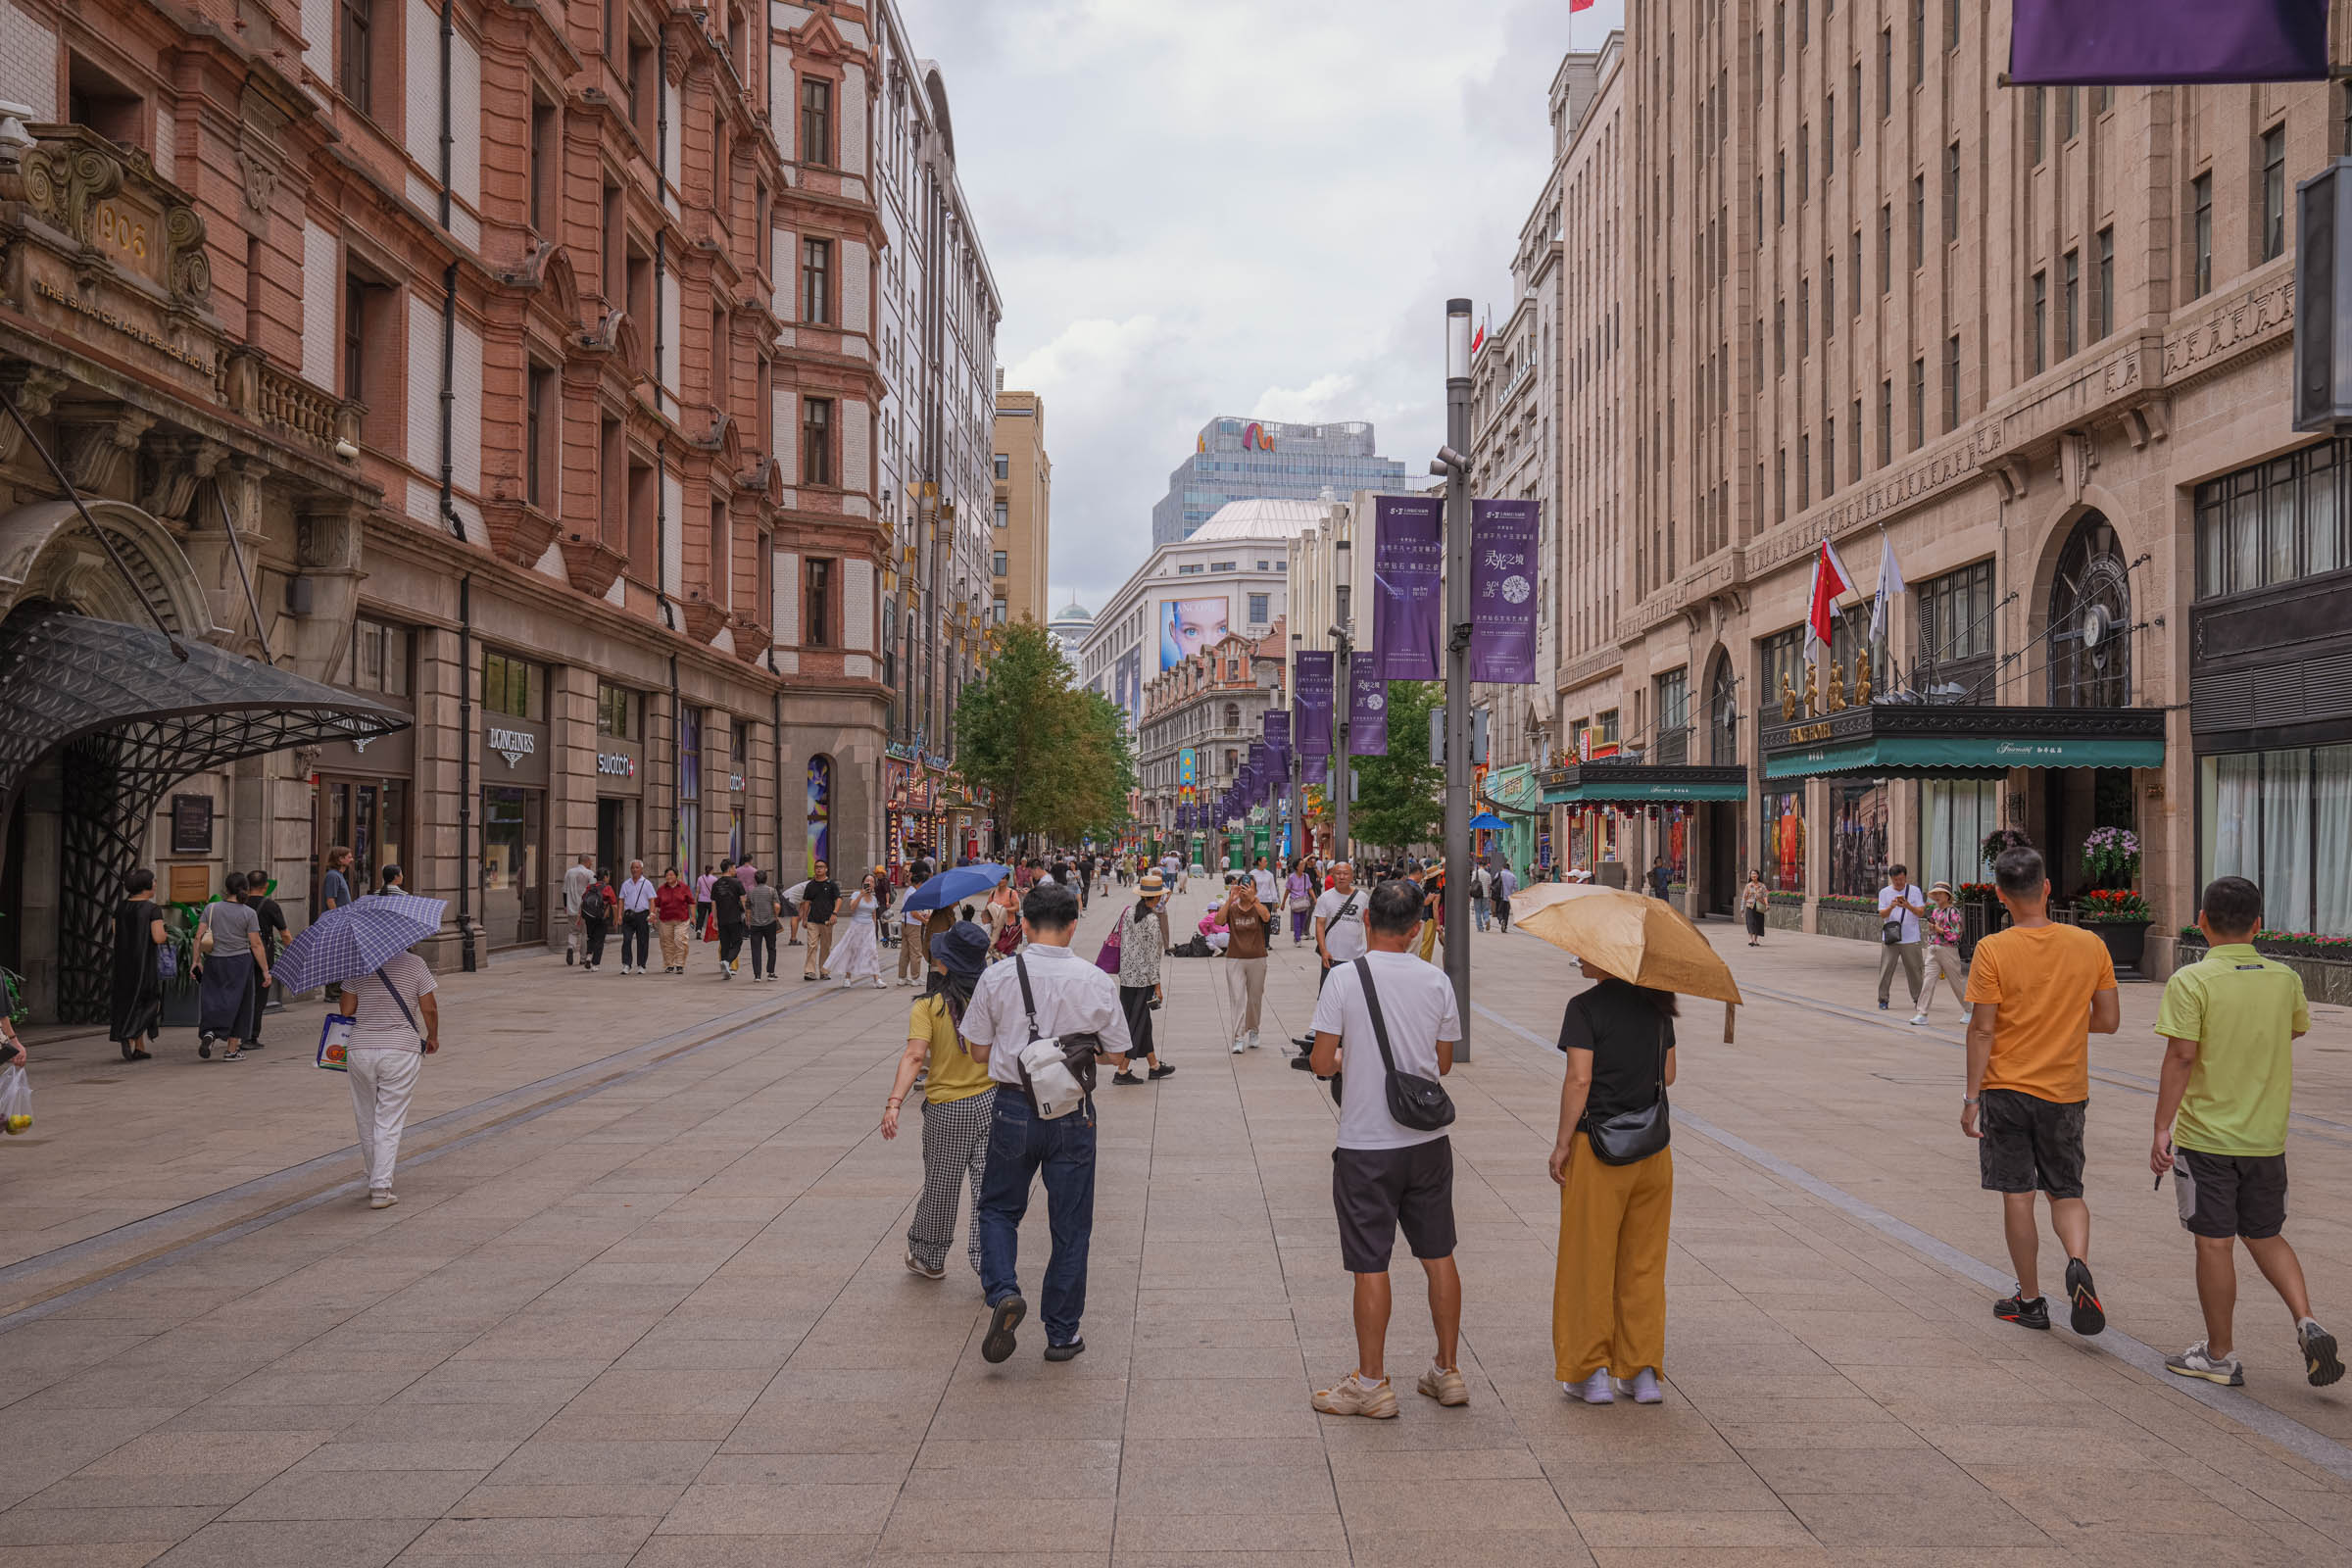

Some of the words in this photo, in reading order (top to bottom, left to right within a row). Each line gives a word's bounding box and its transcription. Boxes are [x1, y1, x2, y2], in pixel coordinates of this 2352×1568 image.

[97, 203, 146, 259] 1906
[40, 281, 64, 302] THE
[70, 299, 118, 327] SWATCH
[123, 322, 146, 340] ART
[148, 334, 183, 360] PEACE
[185, 354, 218, 378] HOTEL
[1484, 549, 1524, 570] 灵光之境
[490, 728, 534, 754] LONGINES
[598, 752, 629, 776] swatch
